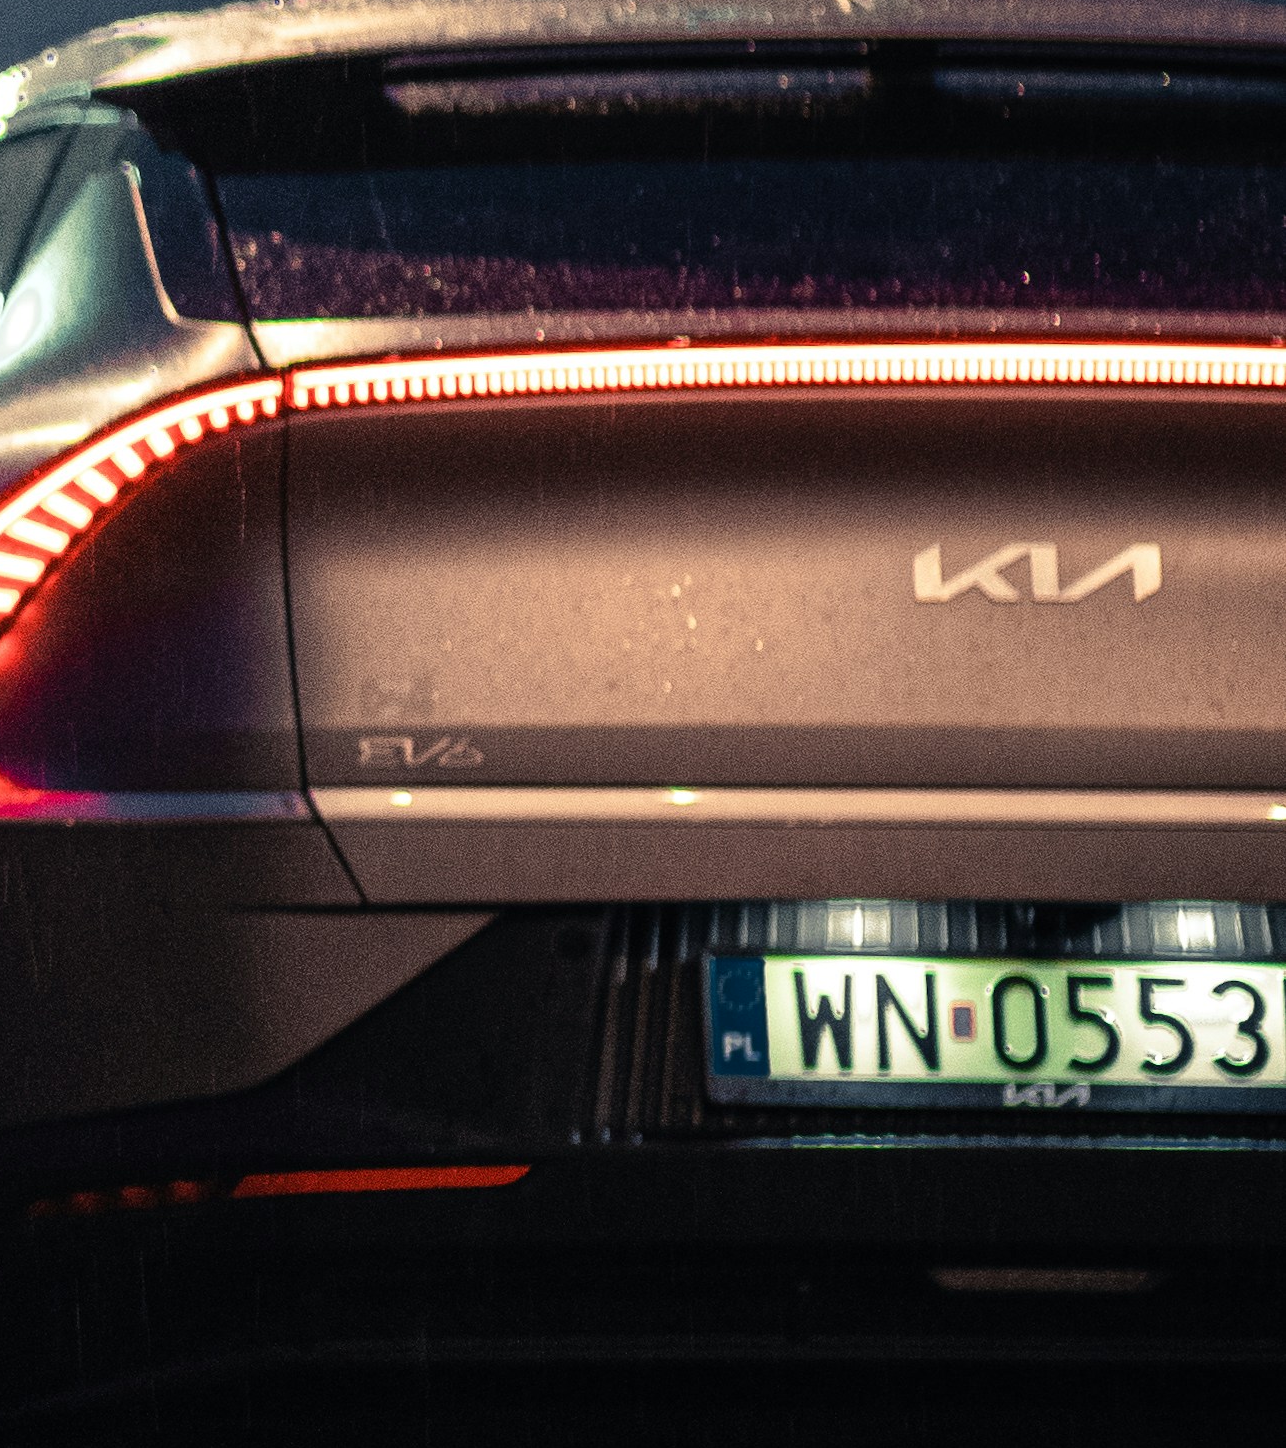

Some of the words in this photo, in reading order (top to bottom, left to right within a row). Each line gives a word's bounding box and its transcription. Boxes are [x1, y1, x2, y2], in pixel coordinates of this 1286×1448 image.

[912, 542, 1162, 603] KIA
[722, 1031, 762, 1062] PL
[792, 971, 941, 1071] WN
[991, 975, 1286, 1077] 0553
[1002, 1082, 1091, 1107] KIA
